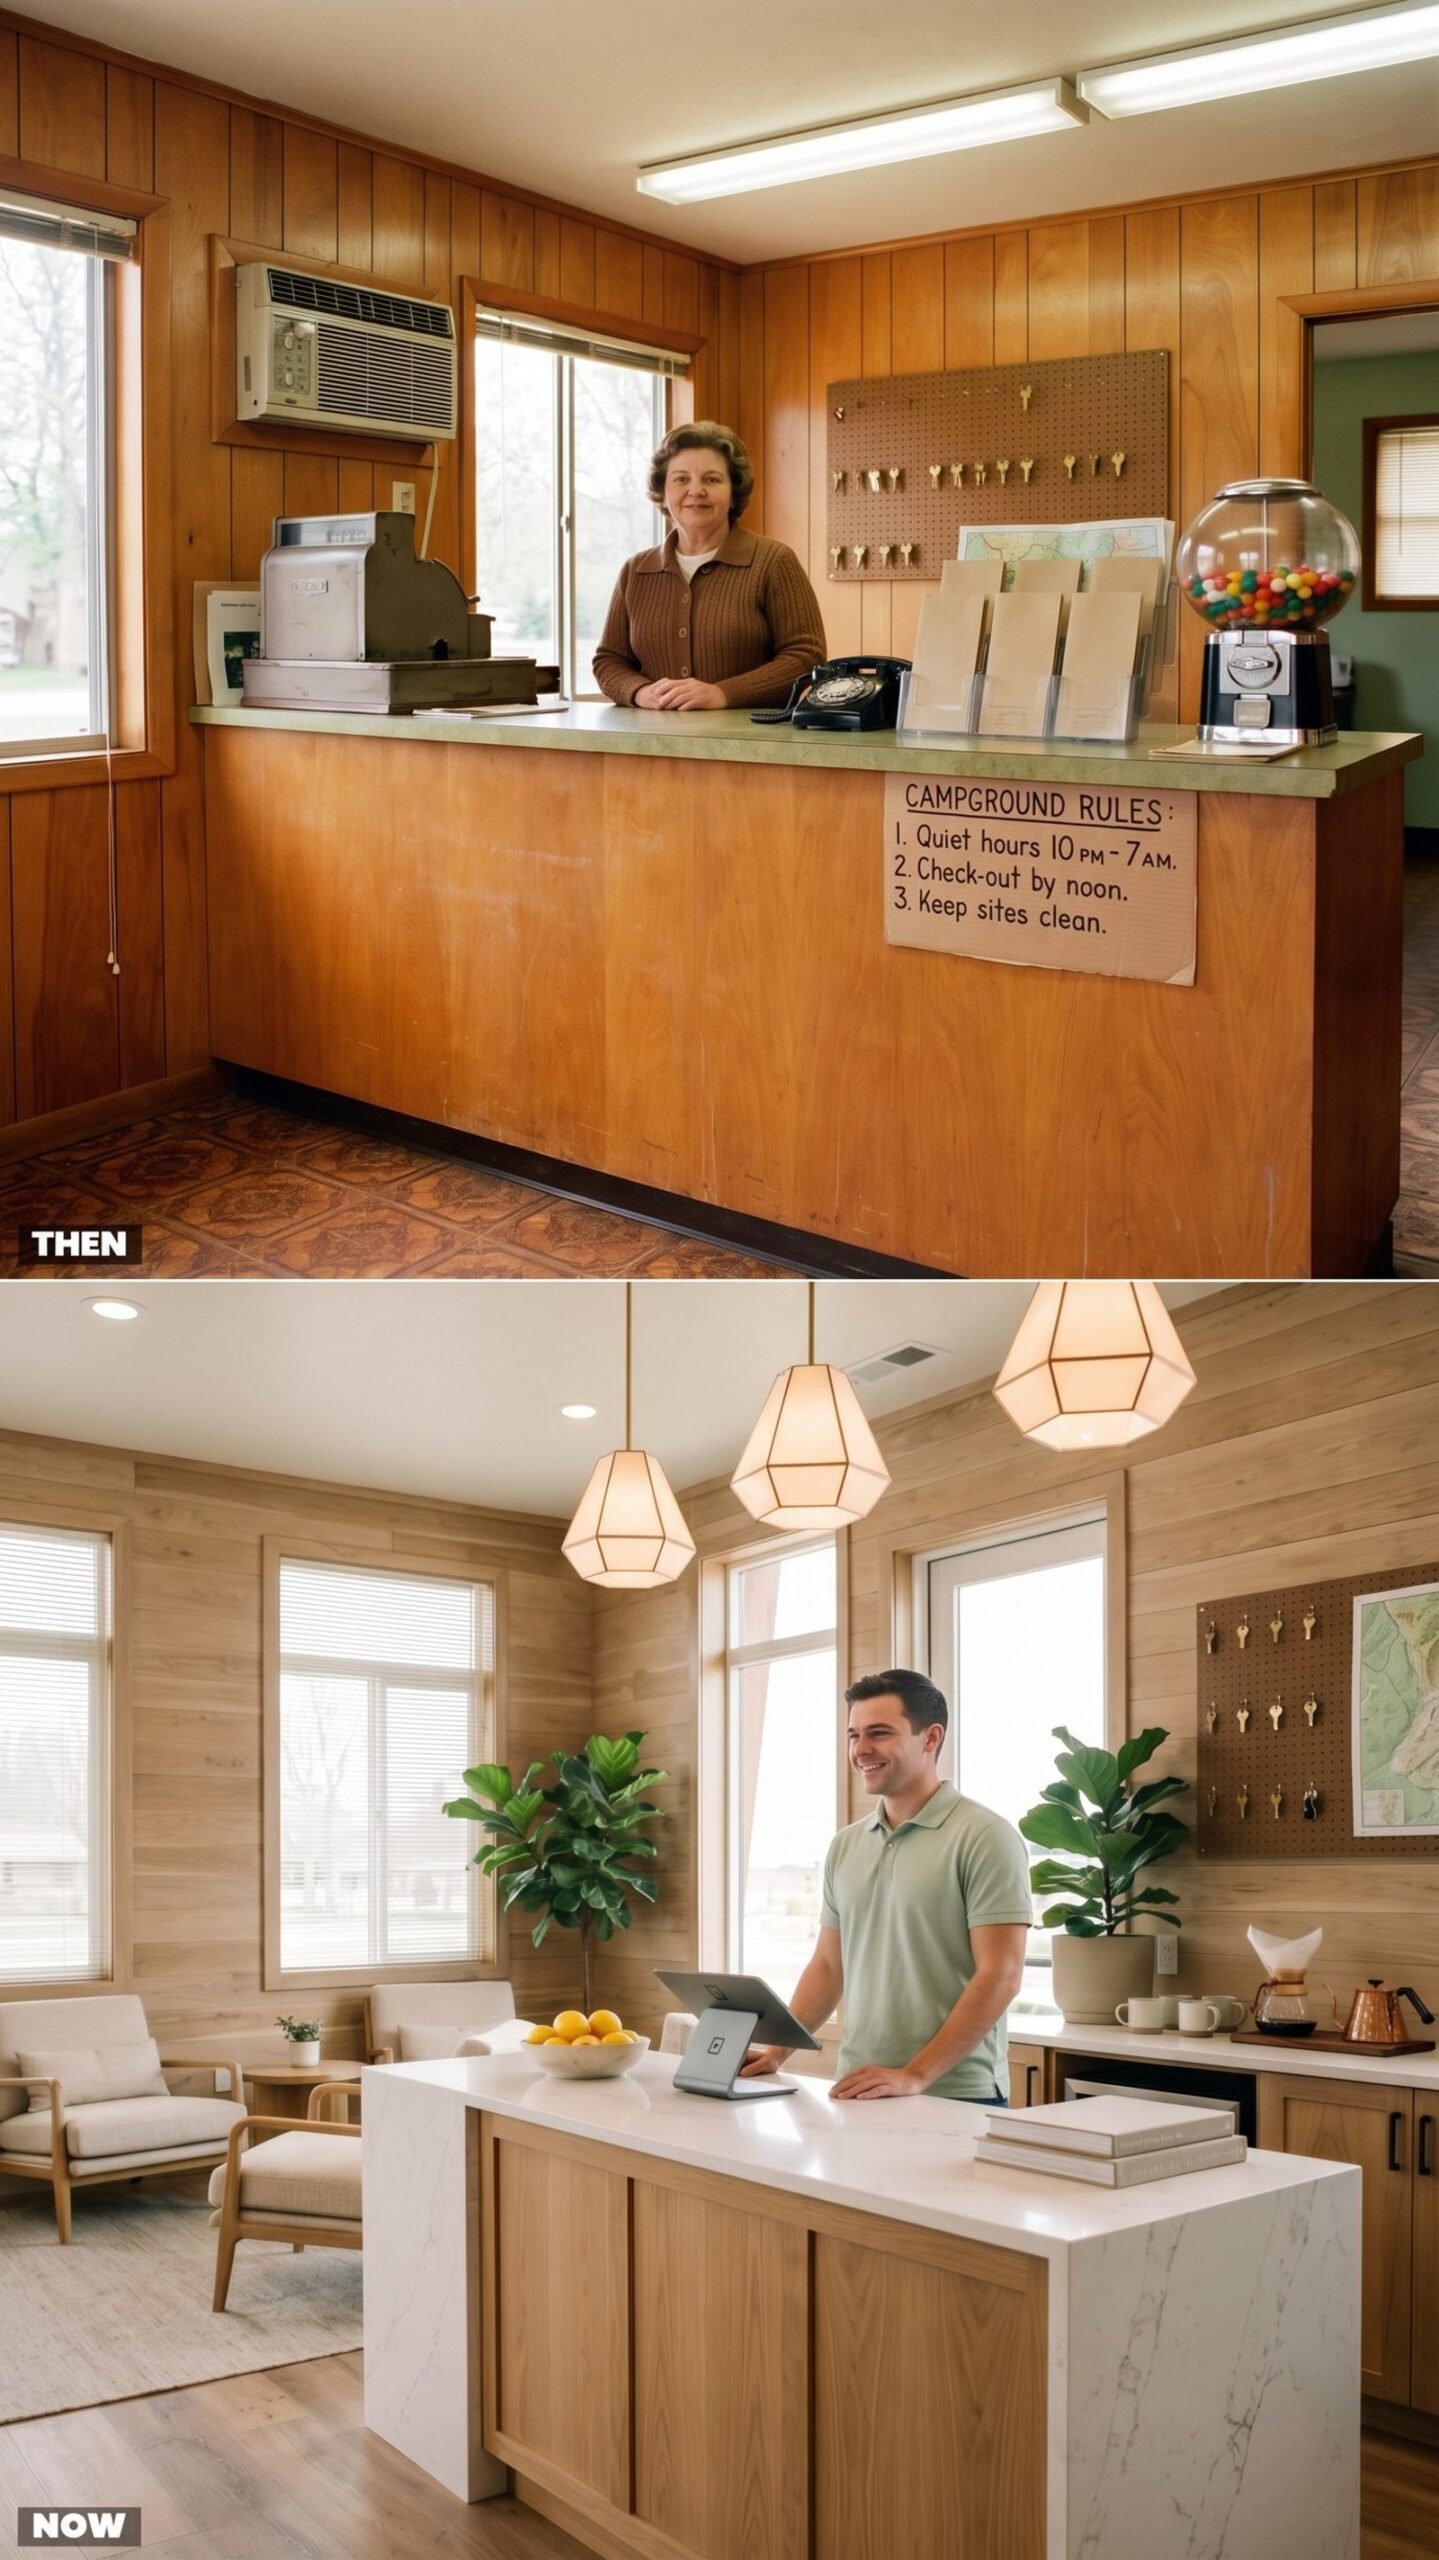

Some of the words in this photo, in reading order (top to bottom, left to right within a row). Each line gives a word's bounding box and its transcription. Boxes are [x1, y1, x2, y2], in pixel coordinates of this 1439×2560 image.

[905, 783, 1066, 818] CAMPGROUND
[1079, 793, 1174, 825] RULES:
[896, 821, 906, 845] 1.
[916, 824, 972, 851] Quiet
[981, 828, 1041, 858] hours
[894, 854, 912, 878] 2.
[917, 856, 1021, 890] Check-out
[1031, 866, 1056, 900] by
[1066, 879, 1128, 902] noon.
[894, 886, 912, 911] 3.
[919, 889, 968, 923] Keep
[977, 898, 1029, 925] sites
[1039, 904, 1107, 935] clean.
